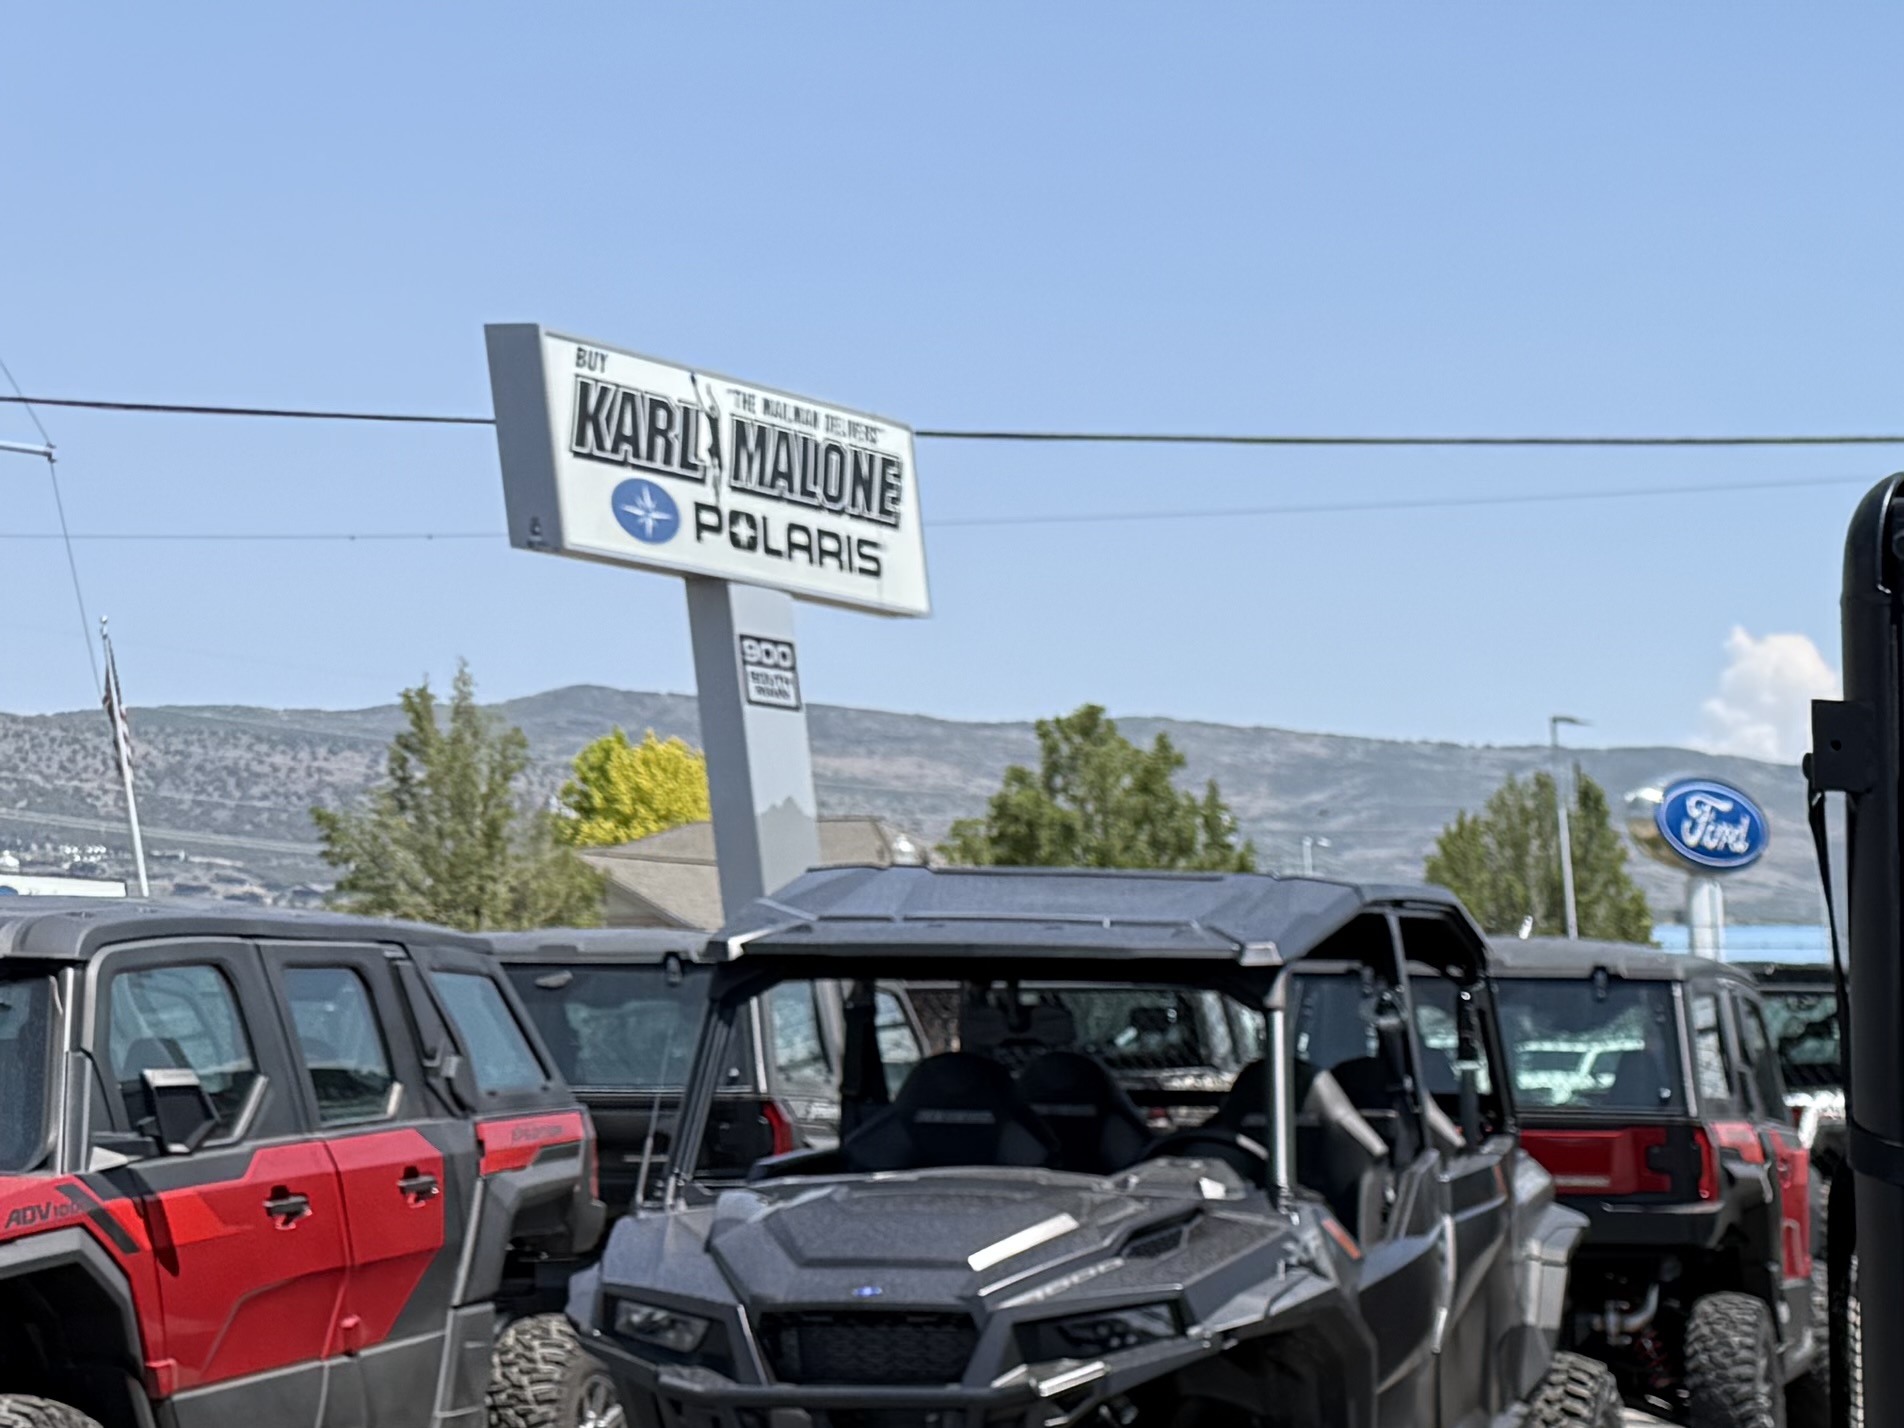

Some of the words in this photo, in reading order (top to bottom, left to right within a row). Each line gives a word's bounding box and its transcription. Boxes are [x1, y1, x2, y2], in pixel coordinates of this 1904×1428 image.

[575, 346, 608, 374] BUY
[571, 376, 706, 481] KARL
[729, 415, 903, 528] MALONE
[694, 500, 883, 578] POLARIS
[743, 638, 794, 668] 900
[1681, 790, 1751, 855] Ford
[5, 1202, 52, 1229] ADV
